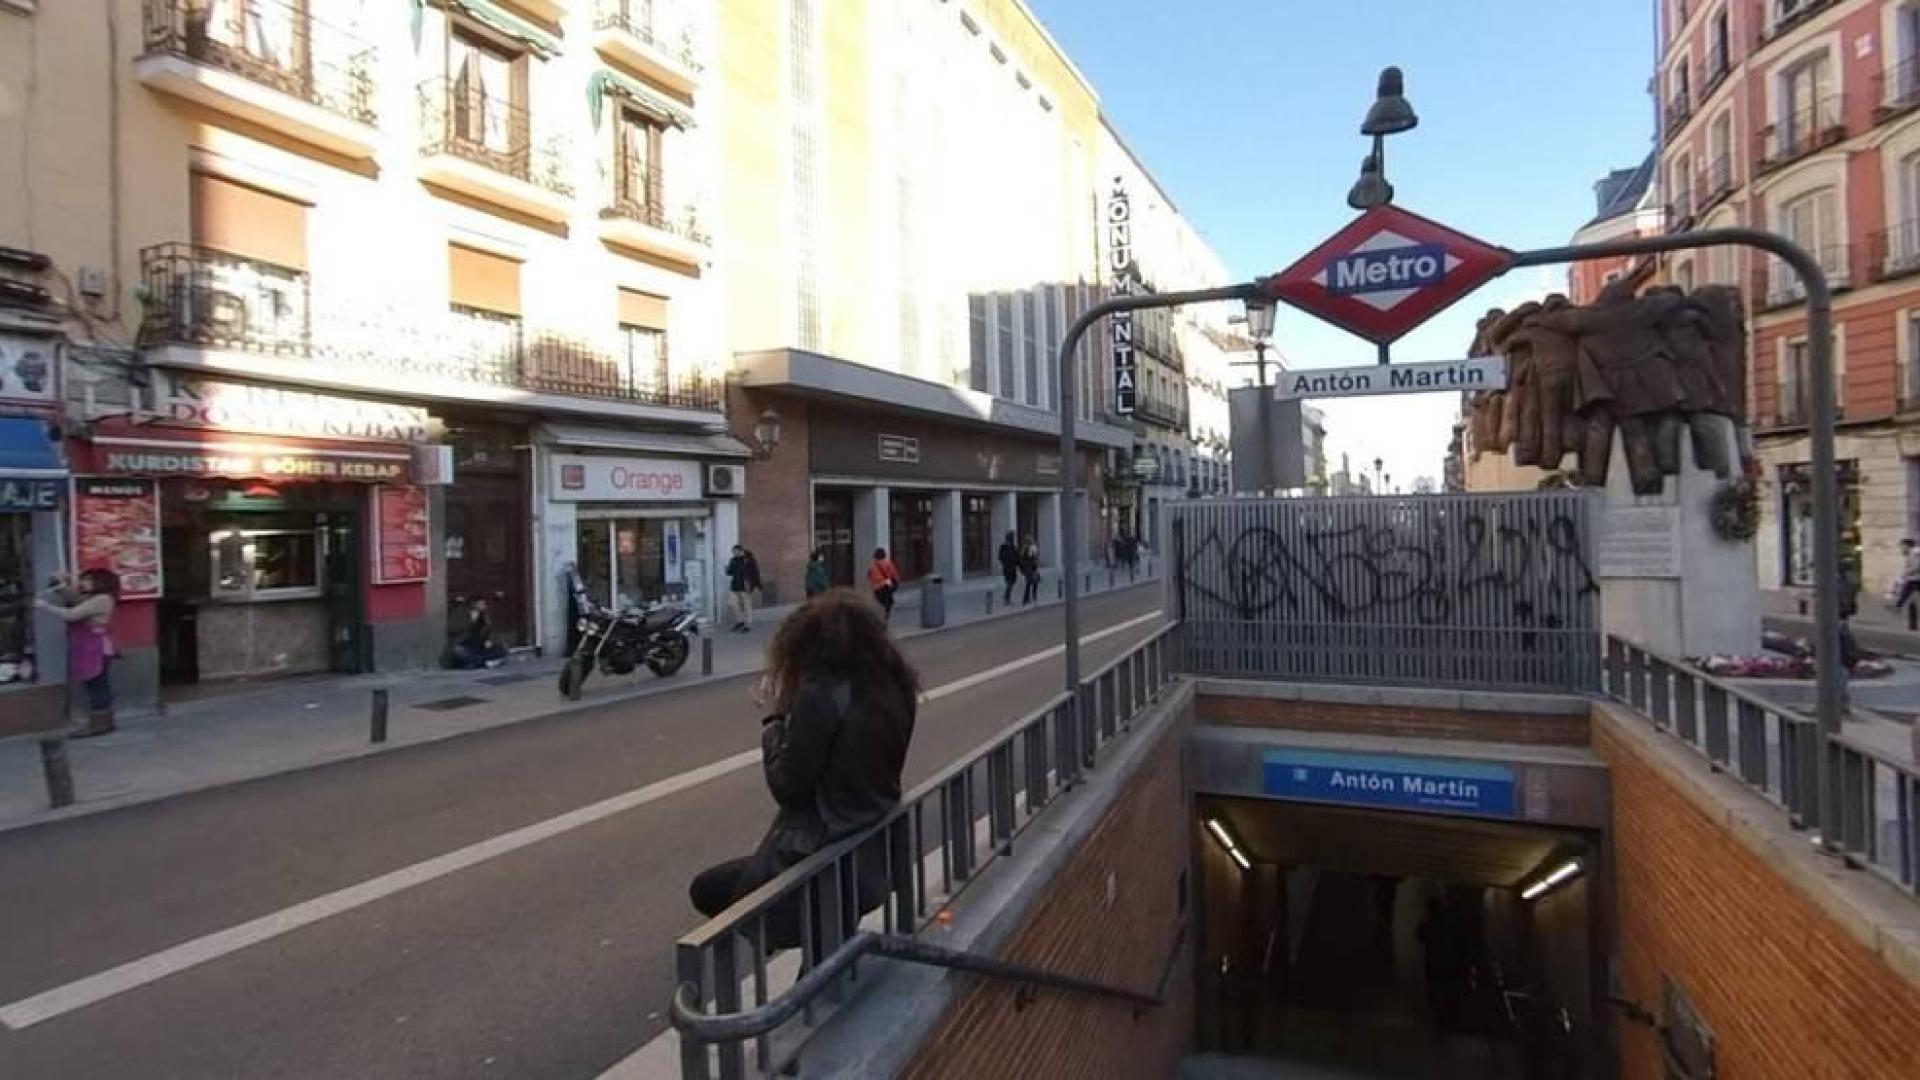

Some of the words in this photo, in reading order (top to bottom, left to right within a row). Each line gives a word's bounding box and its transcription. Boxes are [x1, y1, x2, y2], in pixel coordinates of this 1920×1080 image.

[1336, 254, 1436, 288] Metro
[1293, 371, 1370, 394] Antón
[1389, 364, 1484, 388] Martín
[610, 466, 683, 494] Orange
[1329, 771, 1395, 791] Antón
[1402, 776, 1480, 798] Martín
